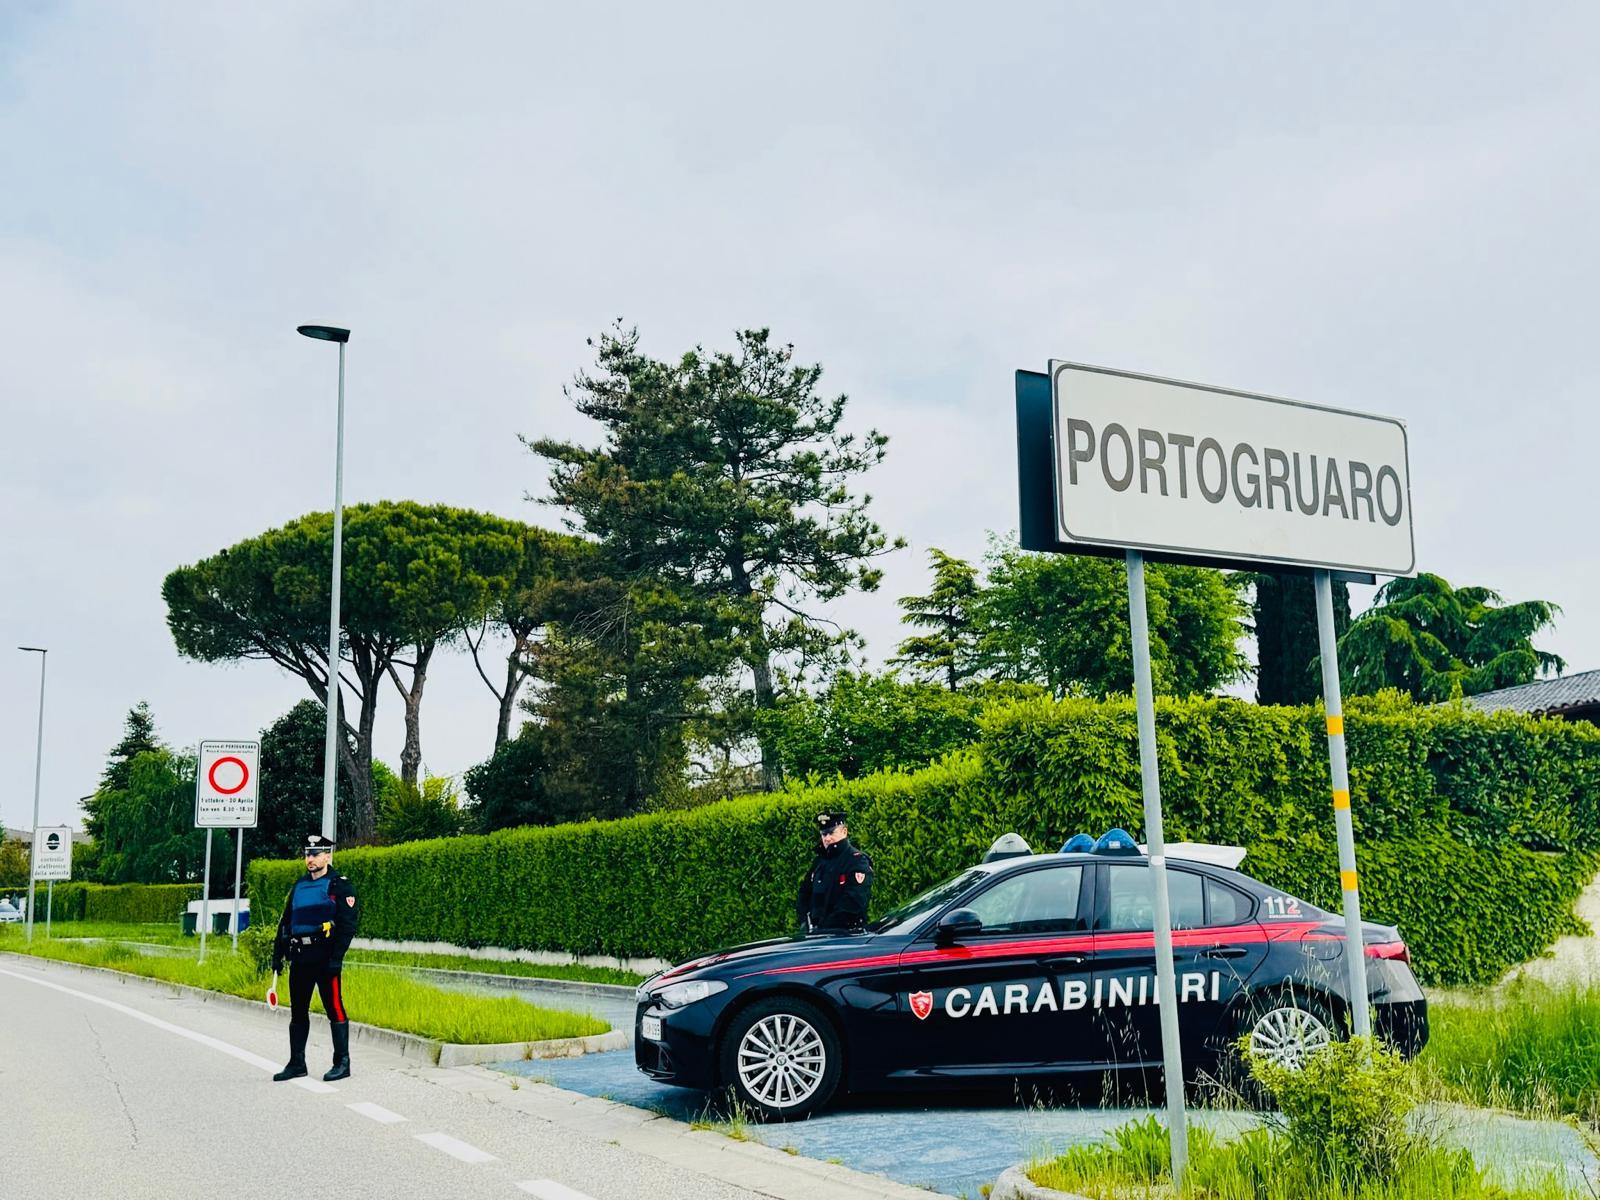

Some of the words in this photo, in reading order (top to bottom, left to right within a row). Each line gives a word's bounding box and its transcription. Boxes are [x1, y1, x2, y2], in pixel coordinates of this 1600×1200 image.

[1067, 417, 1402, 526] PORTOGRUARO
[1263, 896, 1301, 914] 112
[945, 971, 1220, 1018] CARABINIRI
